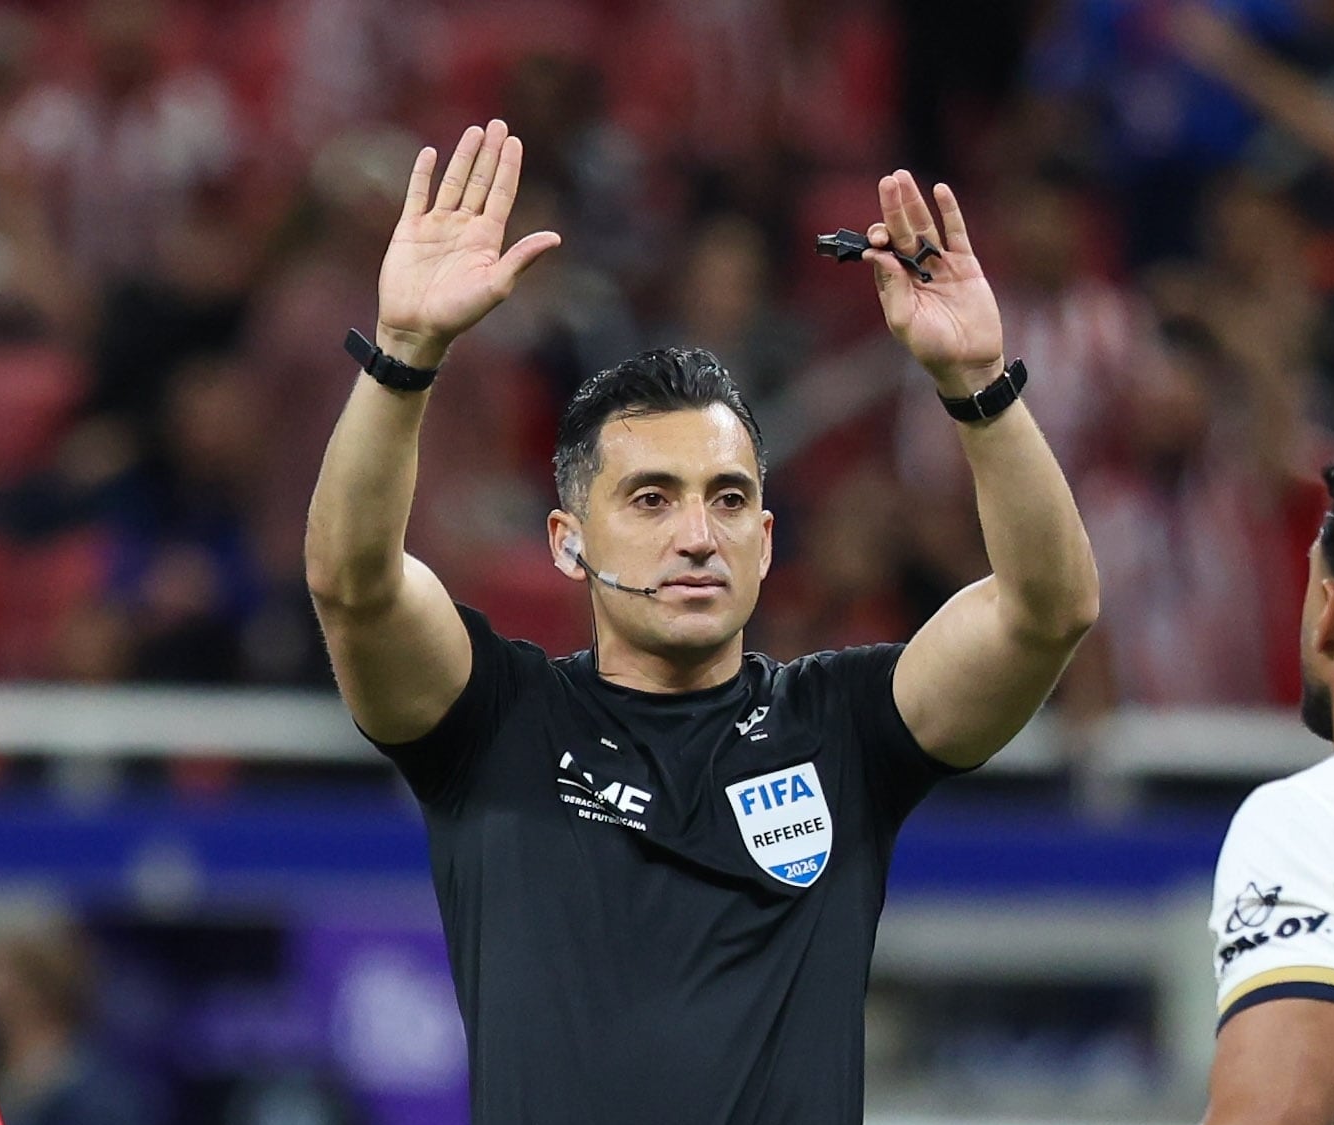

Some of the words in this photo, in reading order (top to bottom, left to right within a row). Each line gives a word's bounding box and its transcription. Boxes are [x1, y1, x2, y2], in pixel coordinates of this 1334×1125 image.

[738, 774, 815, 816] FIFA
[752, 817, 825, 849] REFEREE
[784, 858, 818, 878] 2026
